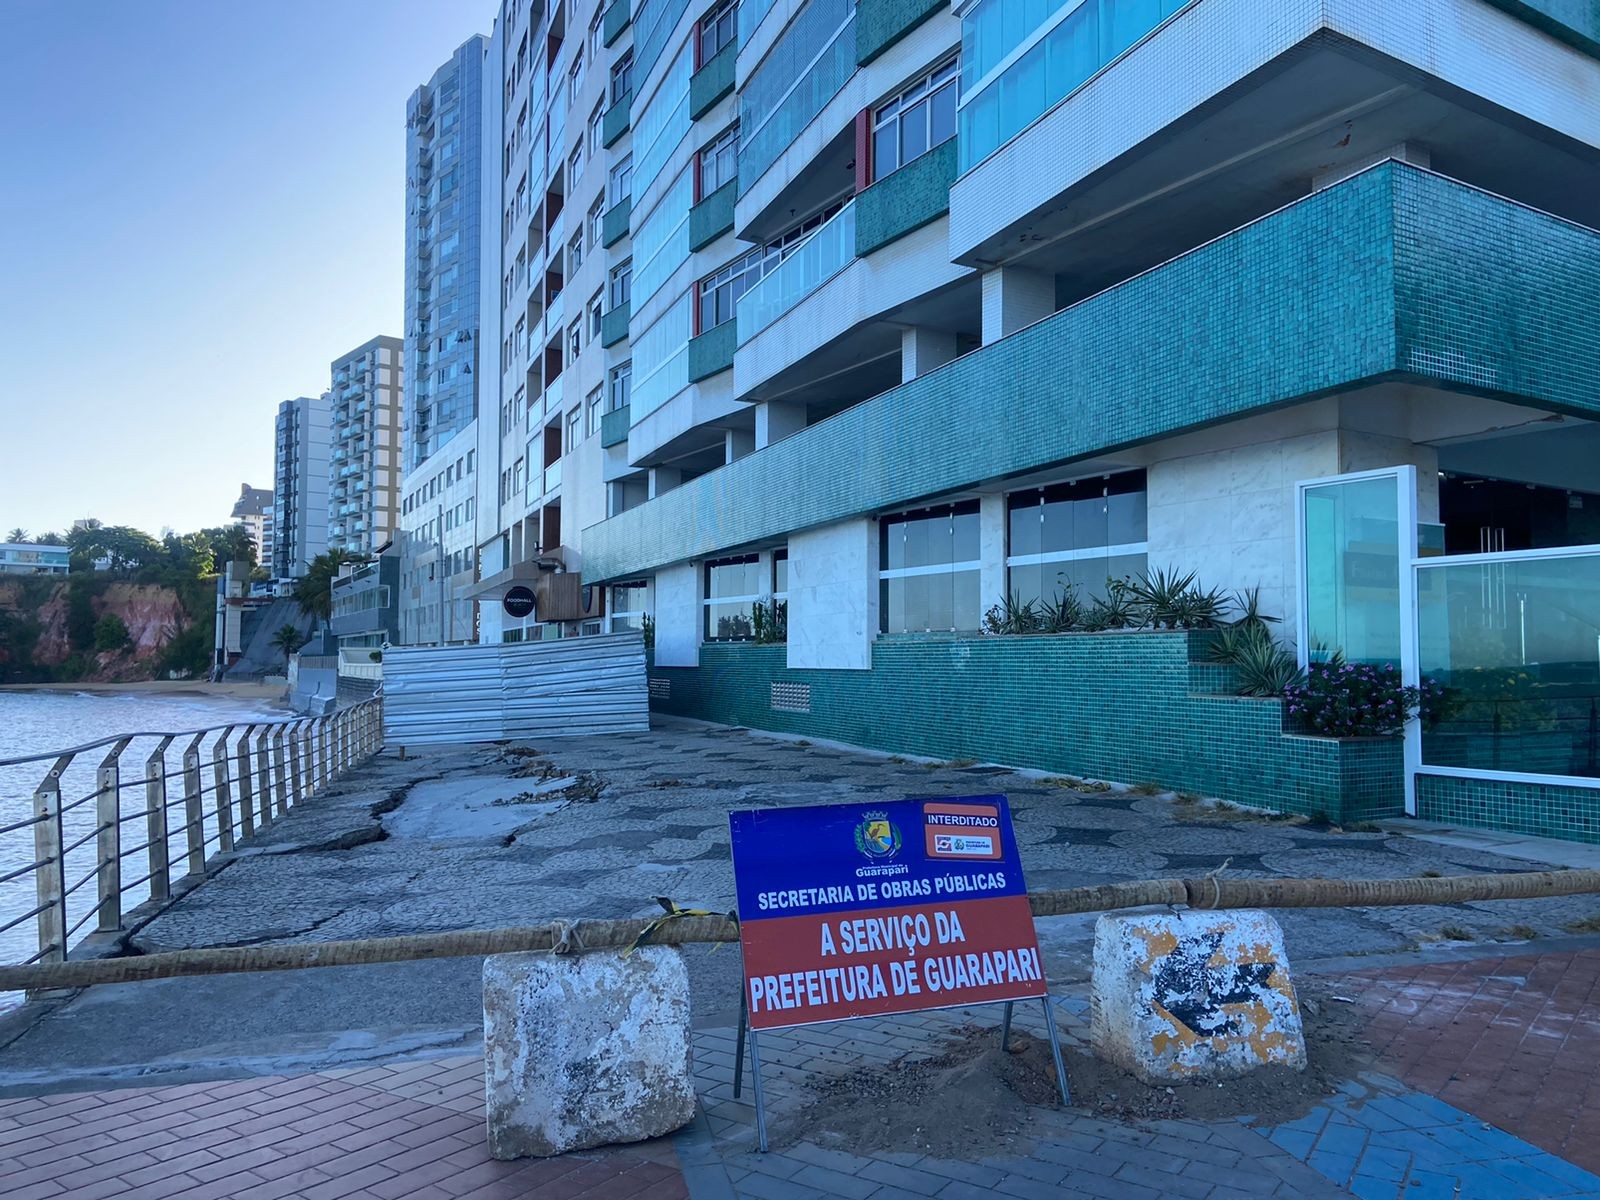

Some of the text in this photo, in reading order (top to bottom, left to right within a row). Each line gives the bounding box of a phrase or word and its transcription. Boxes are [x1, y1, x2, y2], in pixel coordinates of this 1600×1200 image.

[928, 814, 998, 827] INTERDITADO
[855, 865, 909, 877] Guarapari
[758, 872, 1006, 910] SECRETARIA DE OBRAS PÚBLICAS
[821, 910, 965, 956] A SERVIÇO DA
[749, 947, 1041, 1012] PREFEITURA DE GUARAPARI
